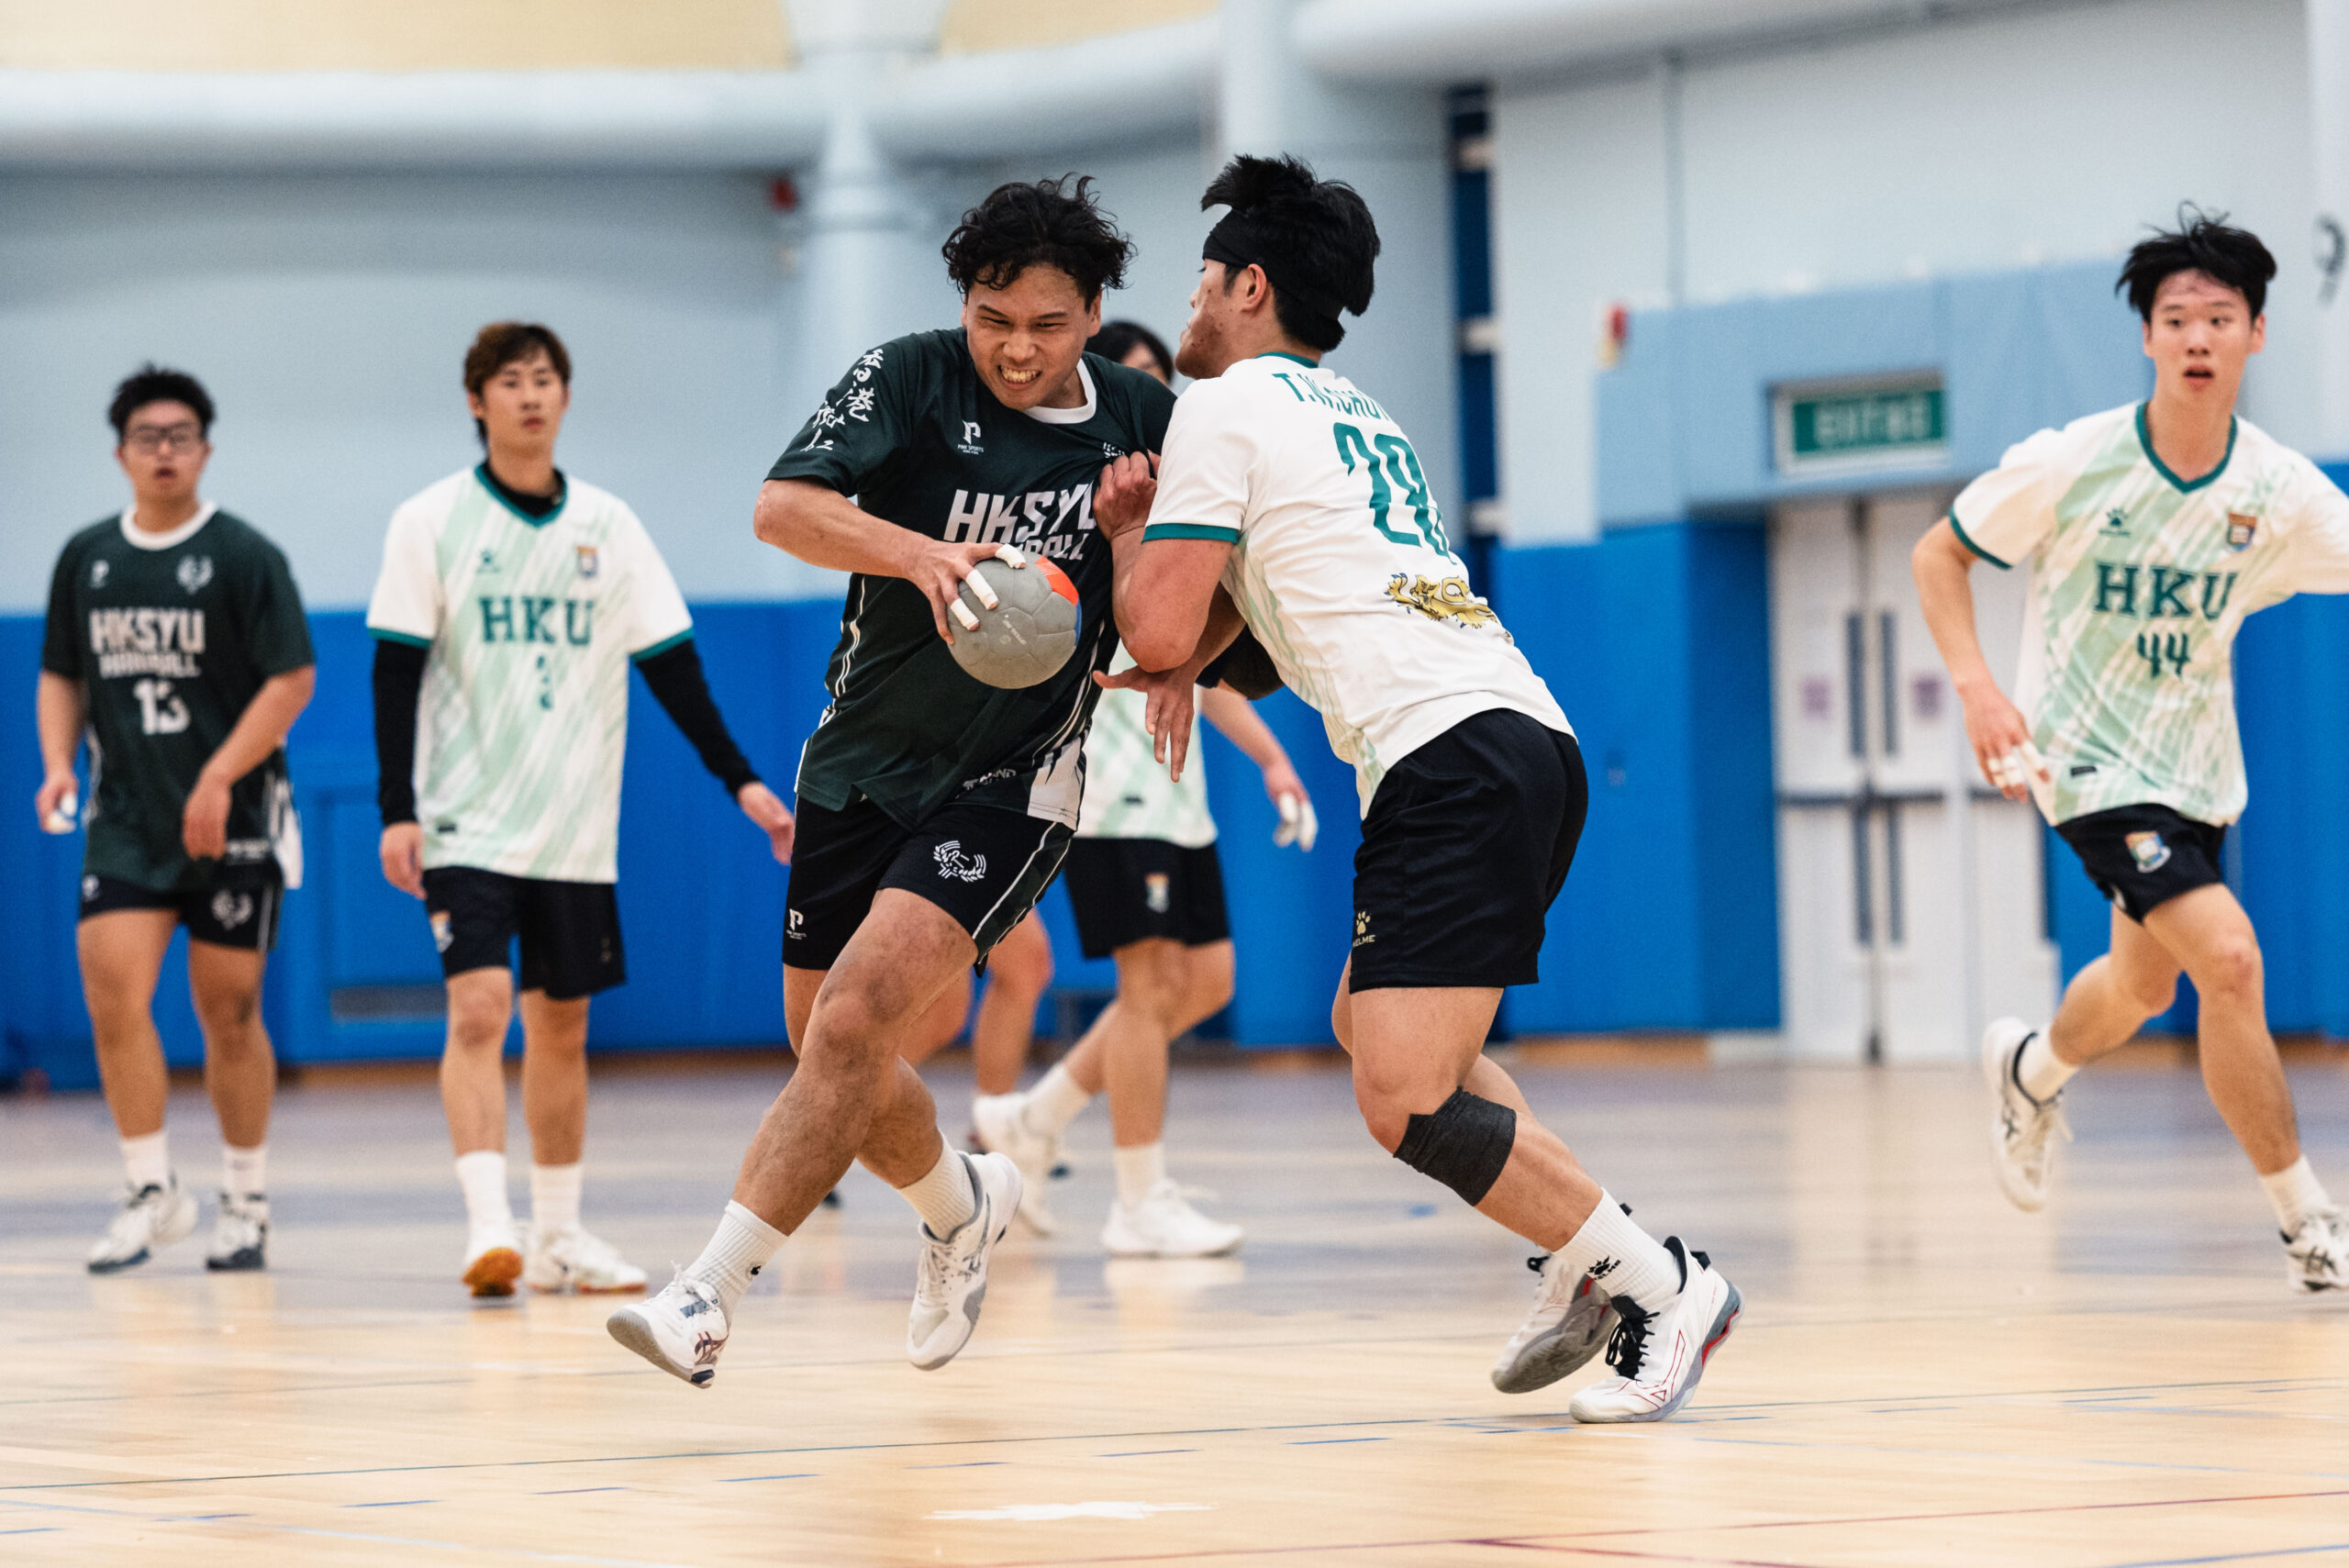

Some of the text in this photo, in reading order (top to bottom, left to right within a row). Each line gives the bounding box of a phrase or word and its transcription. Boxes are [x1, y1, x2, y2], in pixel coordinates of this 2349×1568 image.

[1013, 533, 1089, 560] BALL
[2095, 561, 2239, 621] HKU
[89, 608, 206, 655] HKSYU
[478, 595, 596, 646] HKU
[2137, 632, 2191, 680] 44
[134, 678, 190, 735] 13
